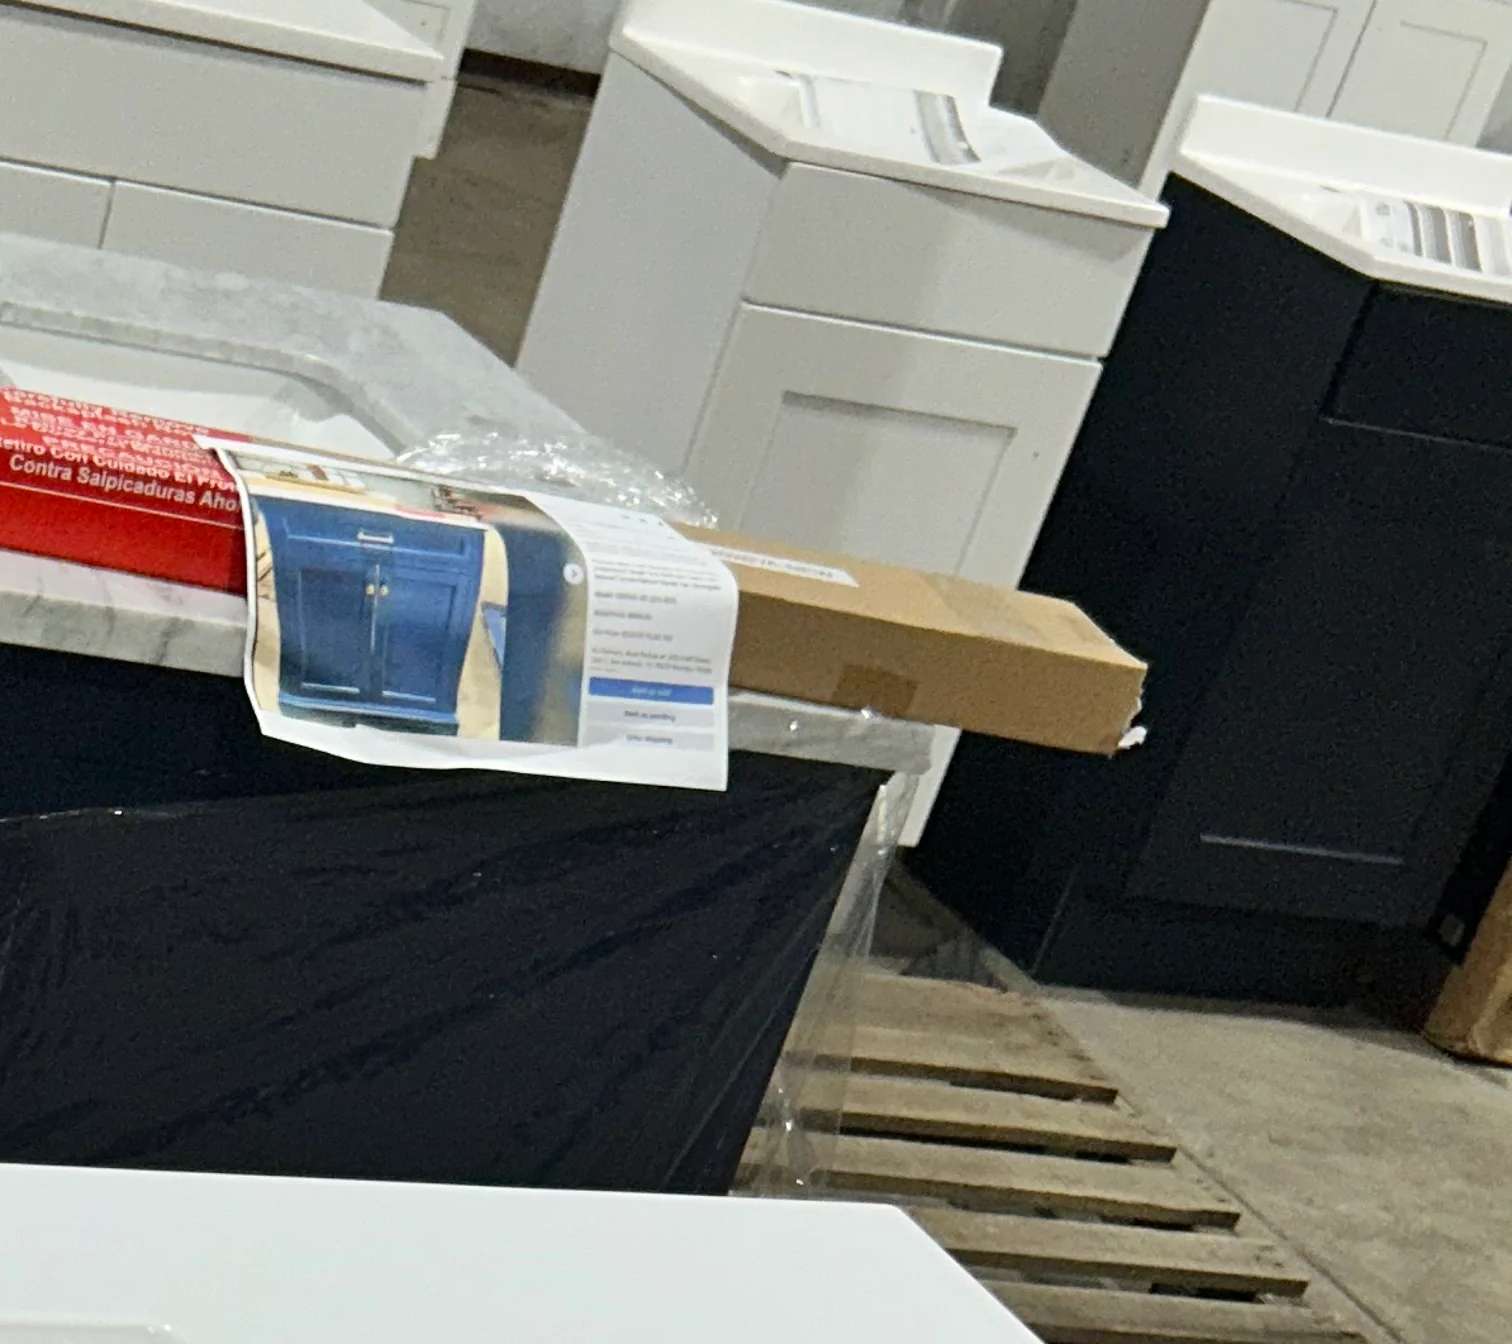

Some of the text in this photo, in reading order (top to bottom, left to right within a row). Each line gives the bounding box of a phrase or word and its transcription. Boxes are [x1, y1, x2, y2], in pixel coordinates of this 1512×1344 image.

[50, 445, 89, 464] Con
[9, 453, 240, 512] Contra Salpicaduras Aho
